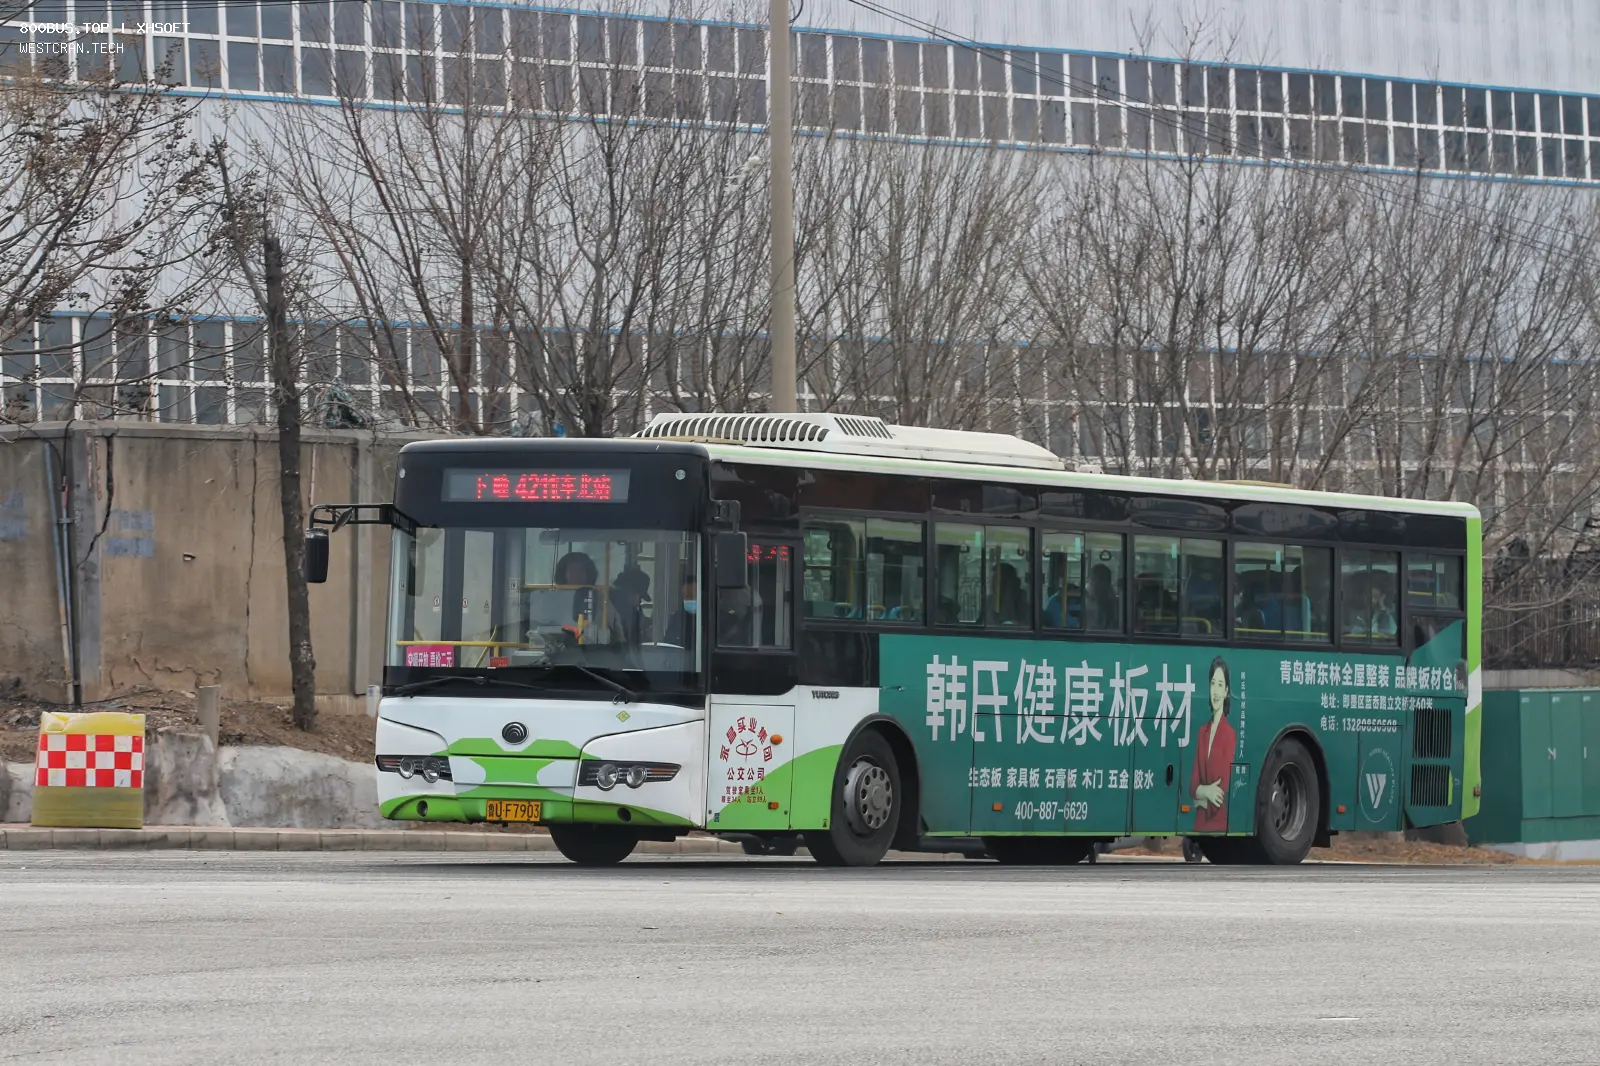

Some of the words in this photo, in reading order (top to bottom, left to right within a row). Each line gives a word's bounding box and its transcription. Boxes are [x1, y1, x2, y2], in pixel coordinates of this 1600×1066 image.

[1280, 660, 1390, 687] 青岛新东林全屋整装
[925, 653, 1196, 748] 韩氏健康板材
[727, 767, 765, 781] 公交公司
[967, 767, 1002, 789] 生态板
[1006, 767, 1040, 789] 家具板
[1044, 767, 1078, 789] 石膏板
[1082, 768, 1104, 789] 木门
[1107, 769, 1129, 789] 五金
[1133, 769, 1154, 790] 胶水
[1014, 801, 1088, 821] 400-887-6629
